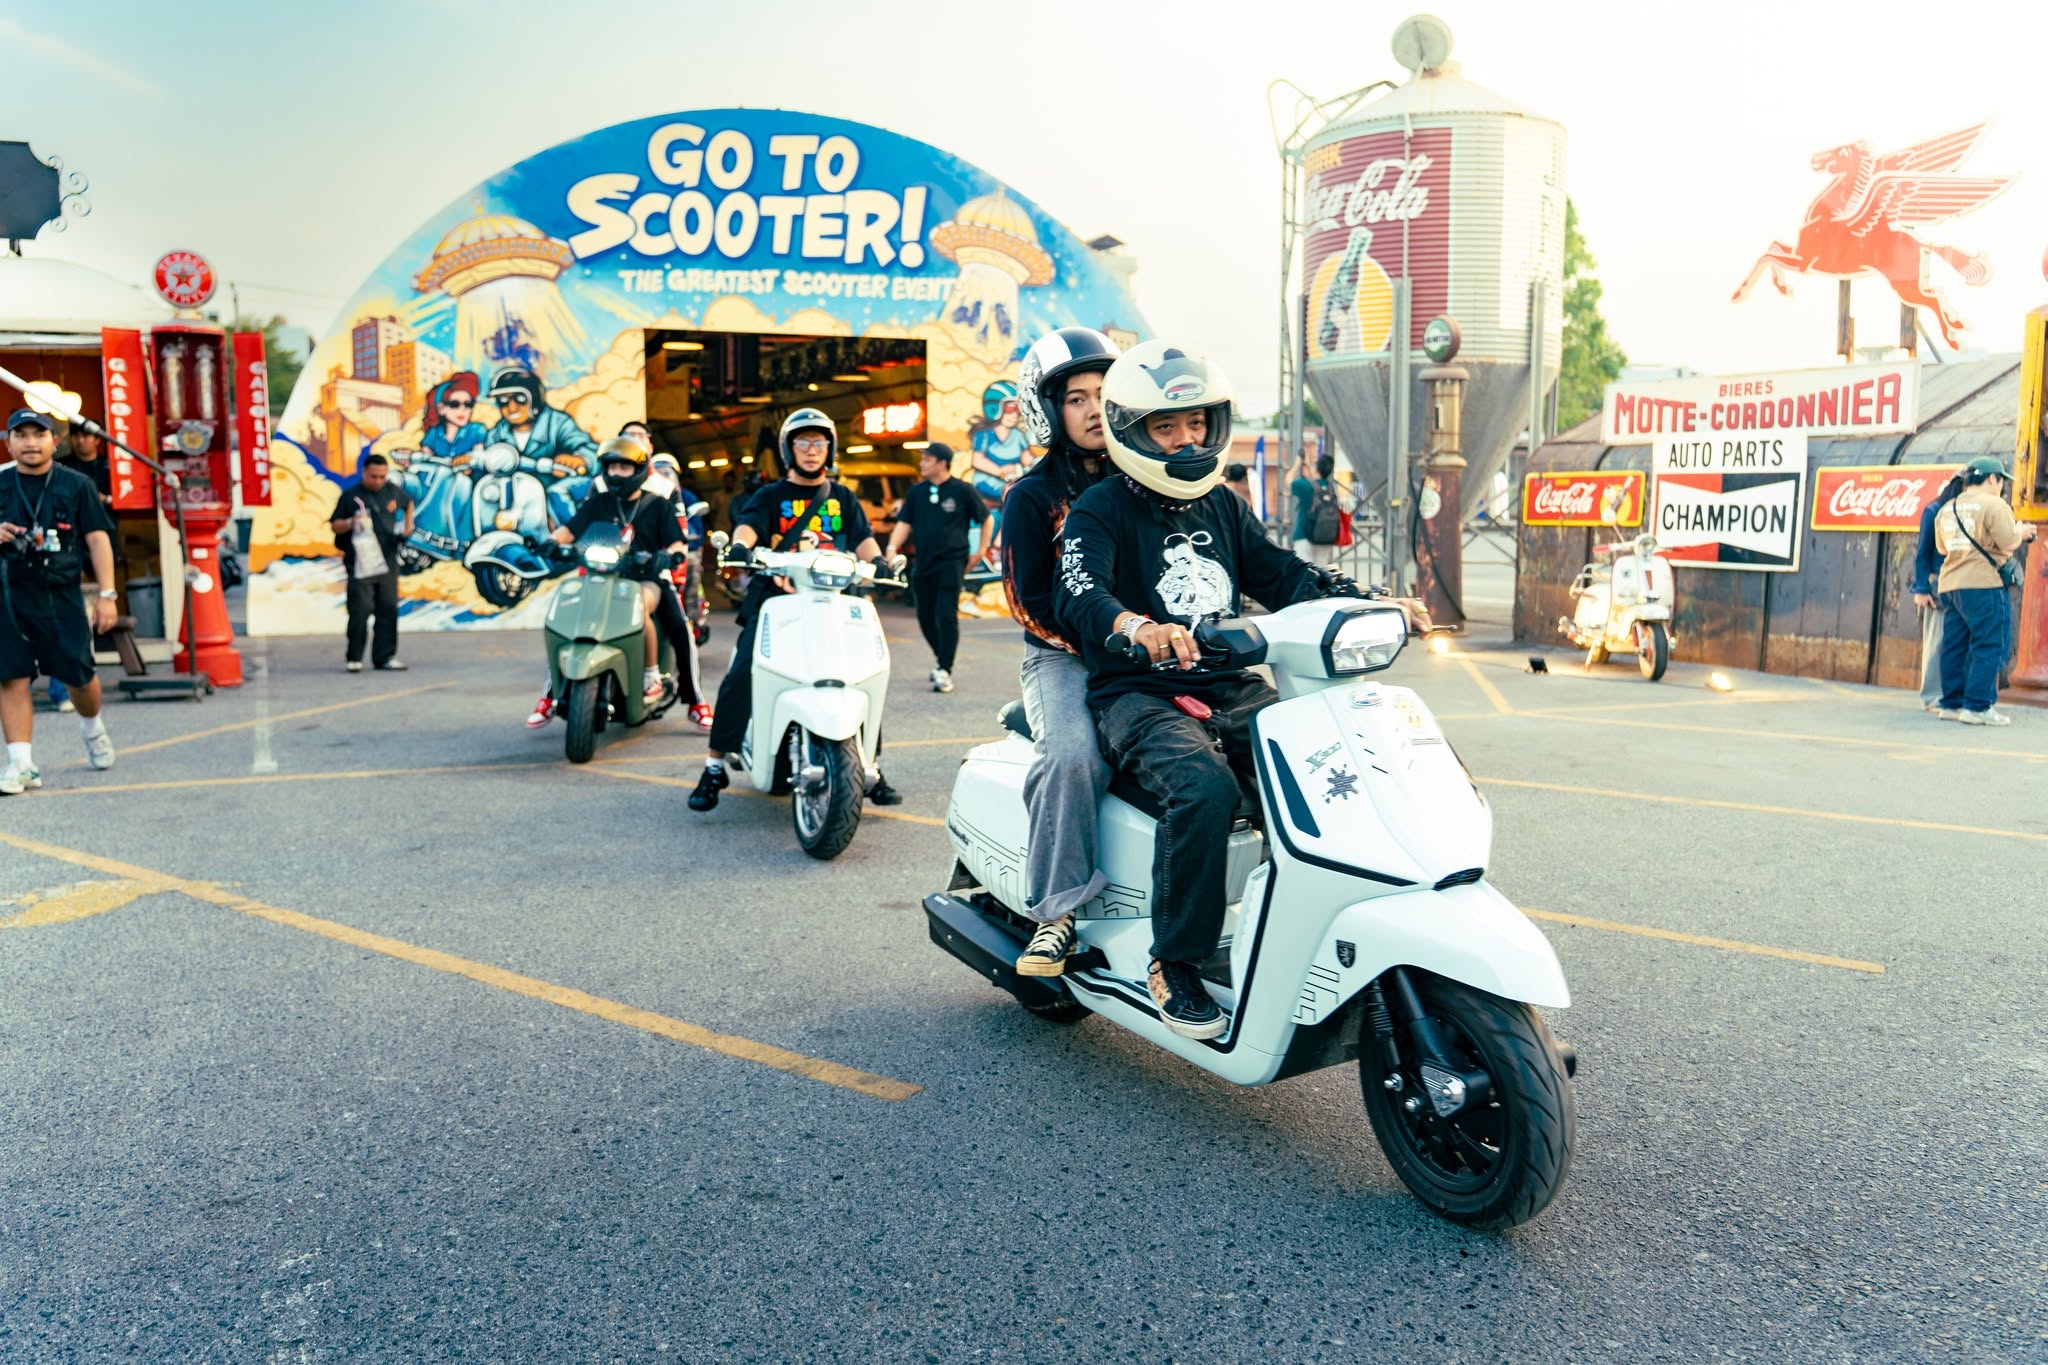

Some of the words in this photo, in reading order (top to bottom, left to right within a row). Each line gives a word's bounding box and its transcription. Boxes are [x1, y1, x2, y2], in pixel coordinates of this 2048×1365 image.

[647, 122, 754, 191] GO
[768, 134, 860, 194] TO
[566, 172, 928, 269] SCOOTER!
[618, 269, 664, 294] THE
[666, 268, 780, 295] GREATEST
[782, 271, 890, 299] SCOOTER
[1613, 372, 1902, 435] MOTTE-CORDONNIER
[1719, 380, 1774, 397] BIERES
[107, 358, 133, 475] GASOLINE
[248, 360, 268, 476] GASOLINE
[1668, 442, 1712, 468] AUTO
[1721, 439, 1784, 467] PARTS
[780, 498, 842, 518] SUER
[1534, 481, 1598, 514] Coca-Cola
[1829, 478, 1927, 517] Coca-Cola
[779, 515, 843, 534] MRIO
[1662, 503, 1787, 533] CHAMPION
